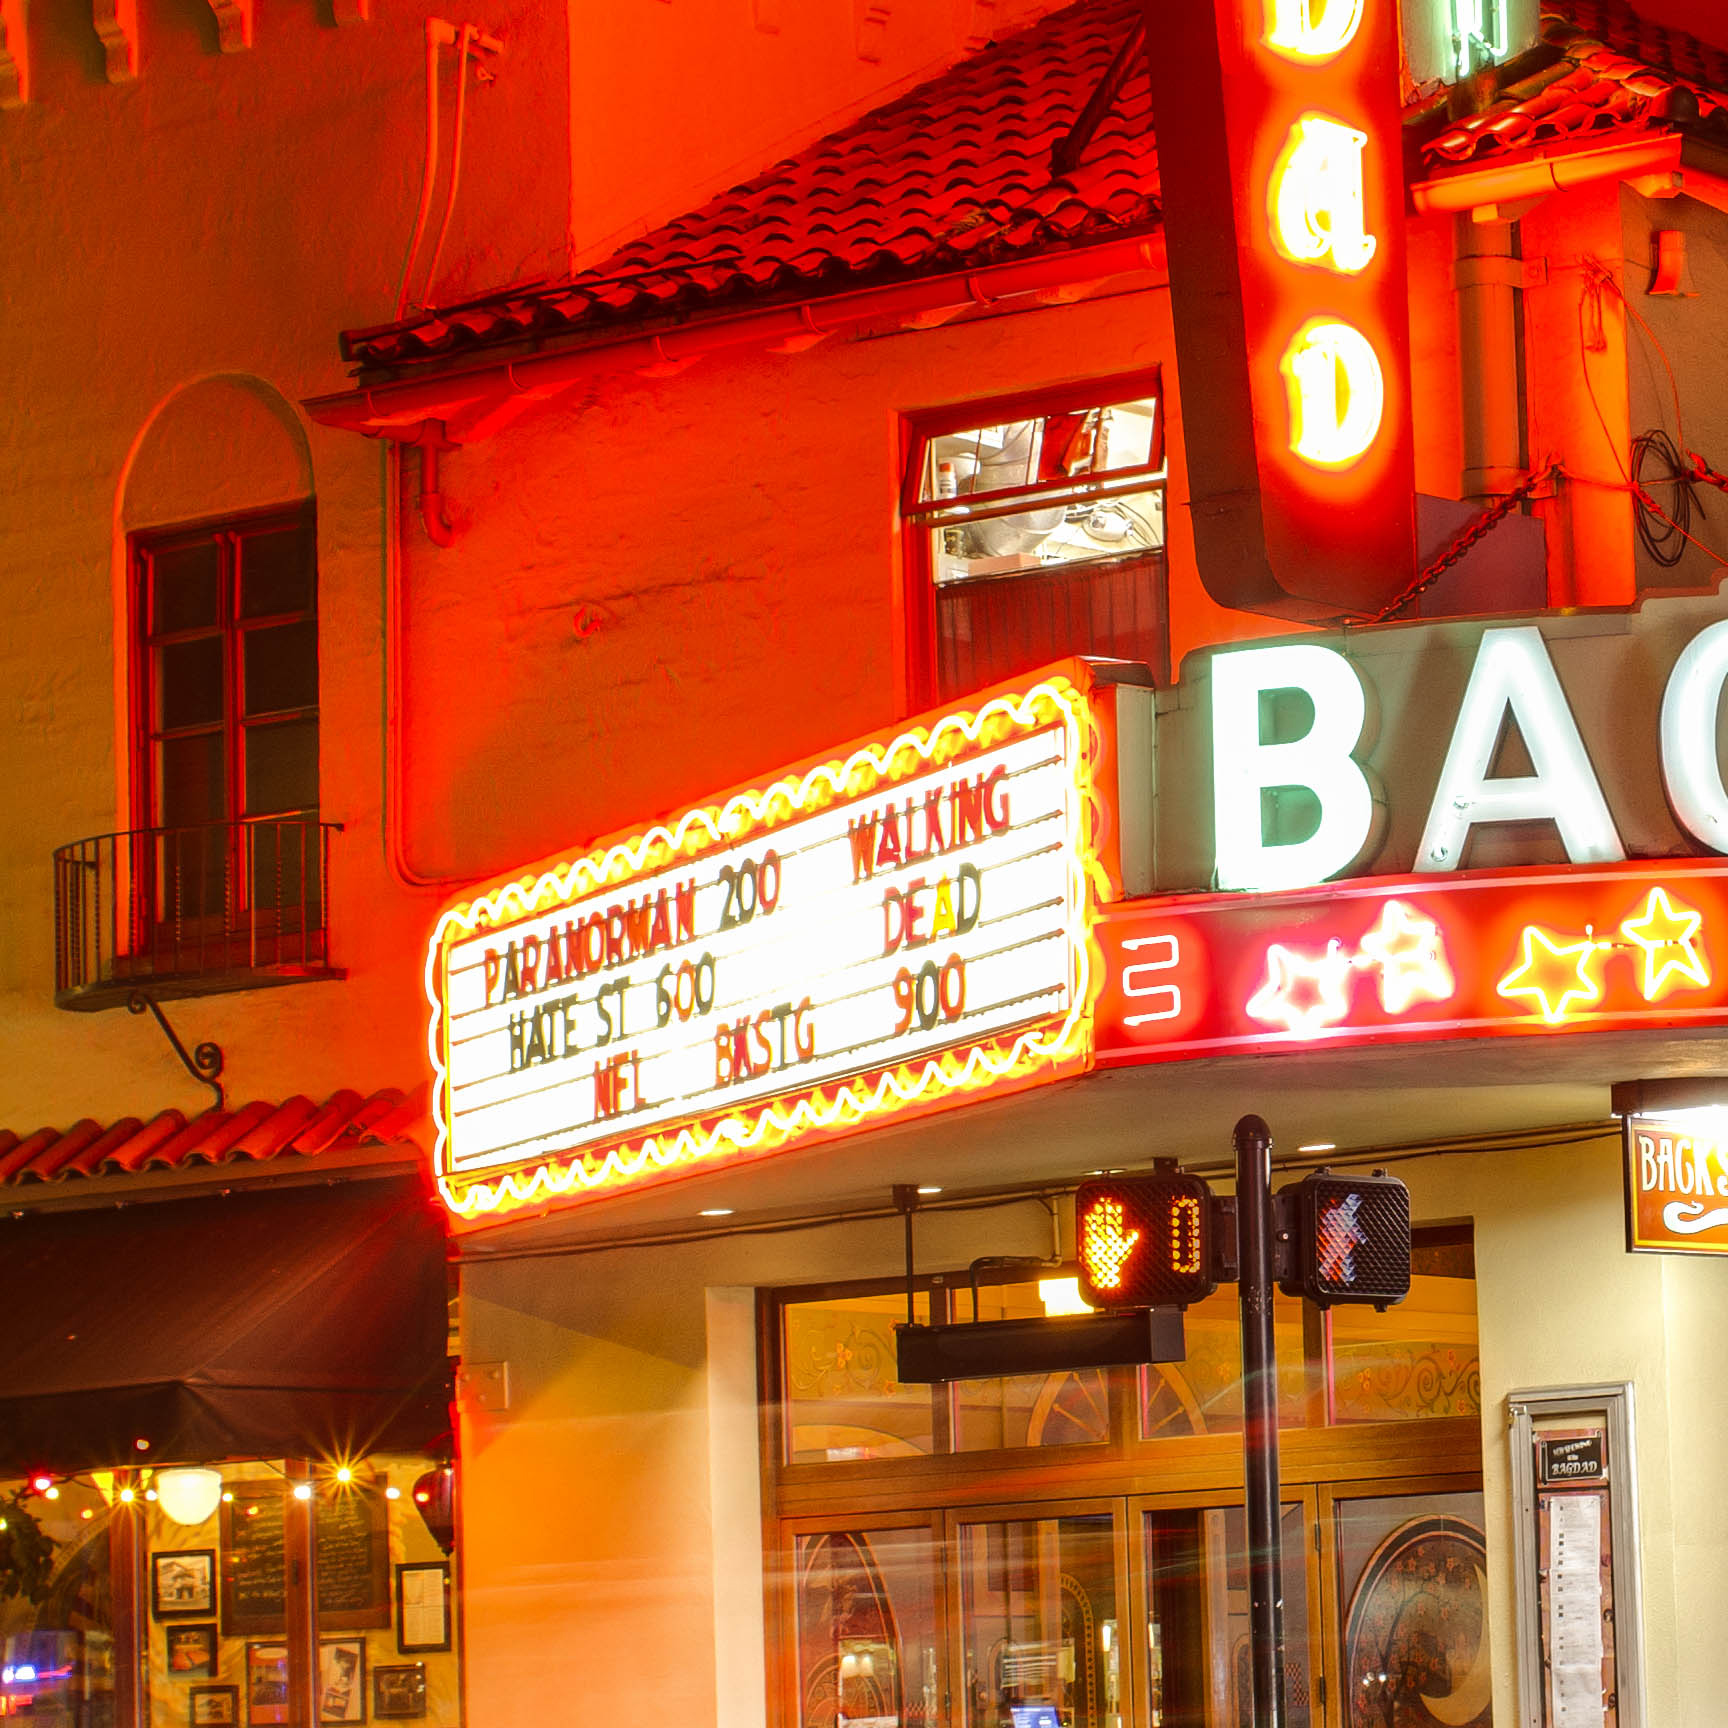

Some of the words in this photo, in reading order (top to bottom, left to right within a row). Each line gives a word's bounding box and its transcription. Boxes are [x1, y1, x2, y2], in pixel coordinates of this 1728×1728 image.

[484, 877, 695, 1009] PARANORMAN
[719, 849, 781, 932] 200
[848, 764, 1010, 883] WALKING
[510, 995, 576, 1072] HATE
[597, 977, 632, 1044] ST
[656, 952, 715, 1027] 600
[882, 862, 981, 956] DEAD
[593, 1048, 645, 1120] NFL
[715, 998, 814, 1088] BKSTG
[895, 952, 965, 1033] 900
[1638, 1135, 1715, 1196] BACK
[1552, 1461, 1597, 1476] BAGDAD
